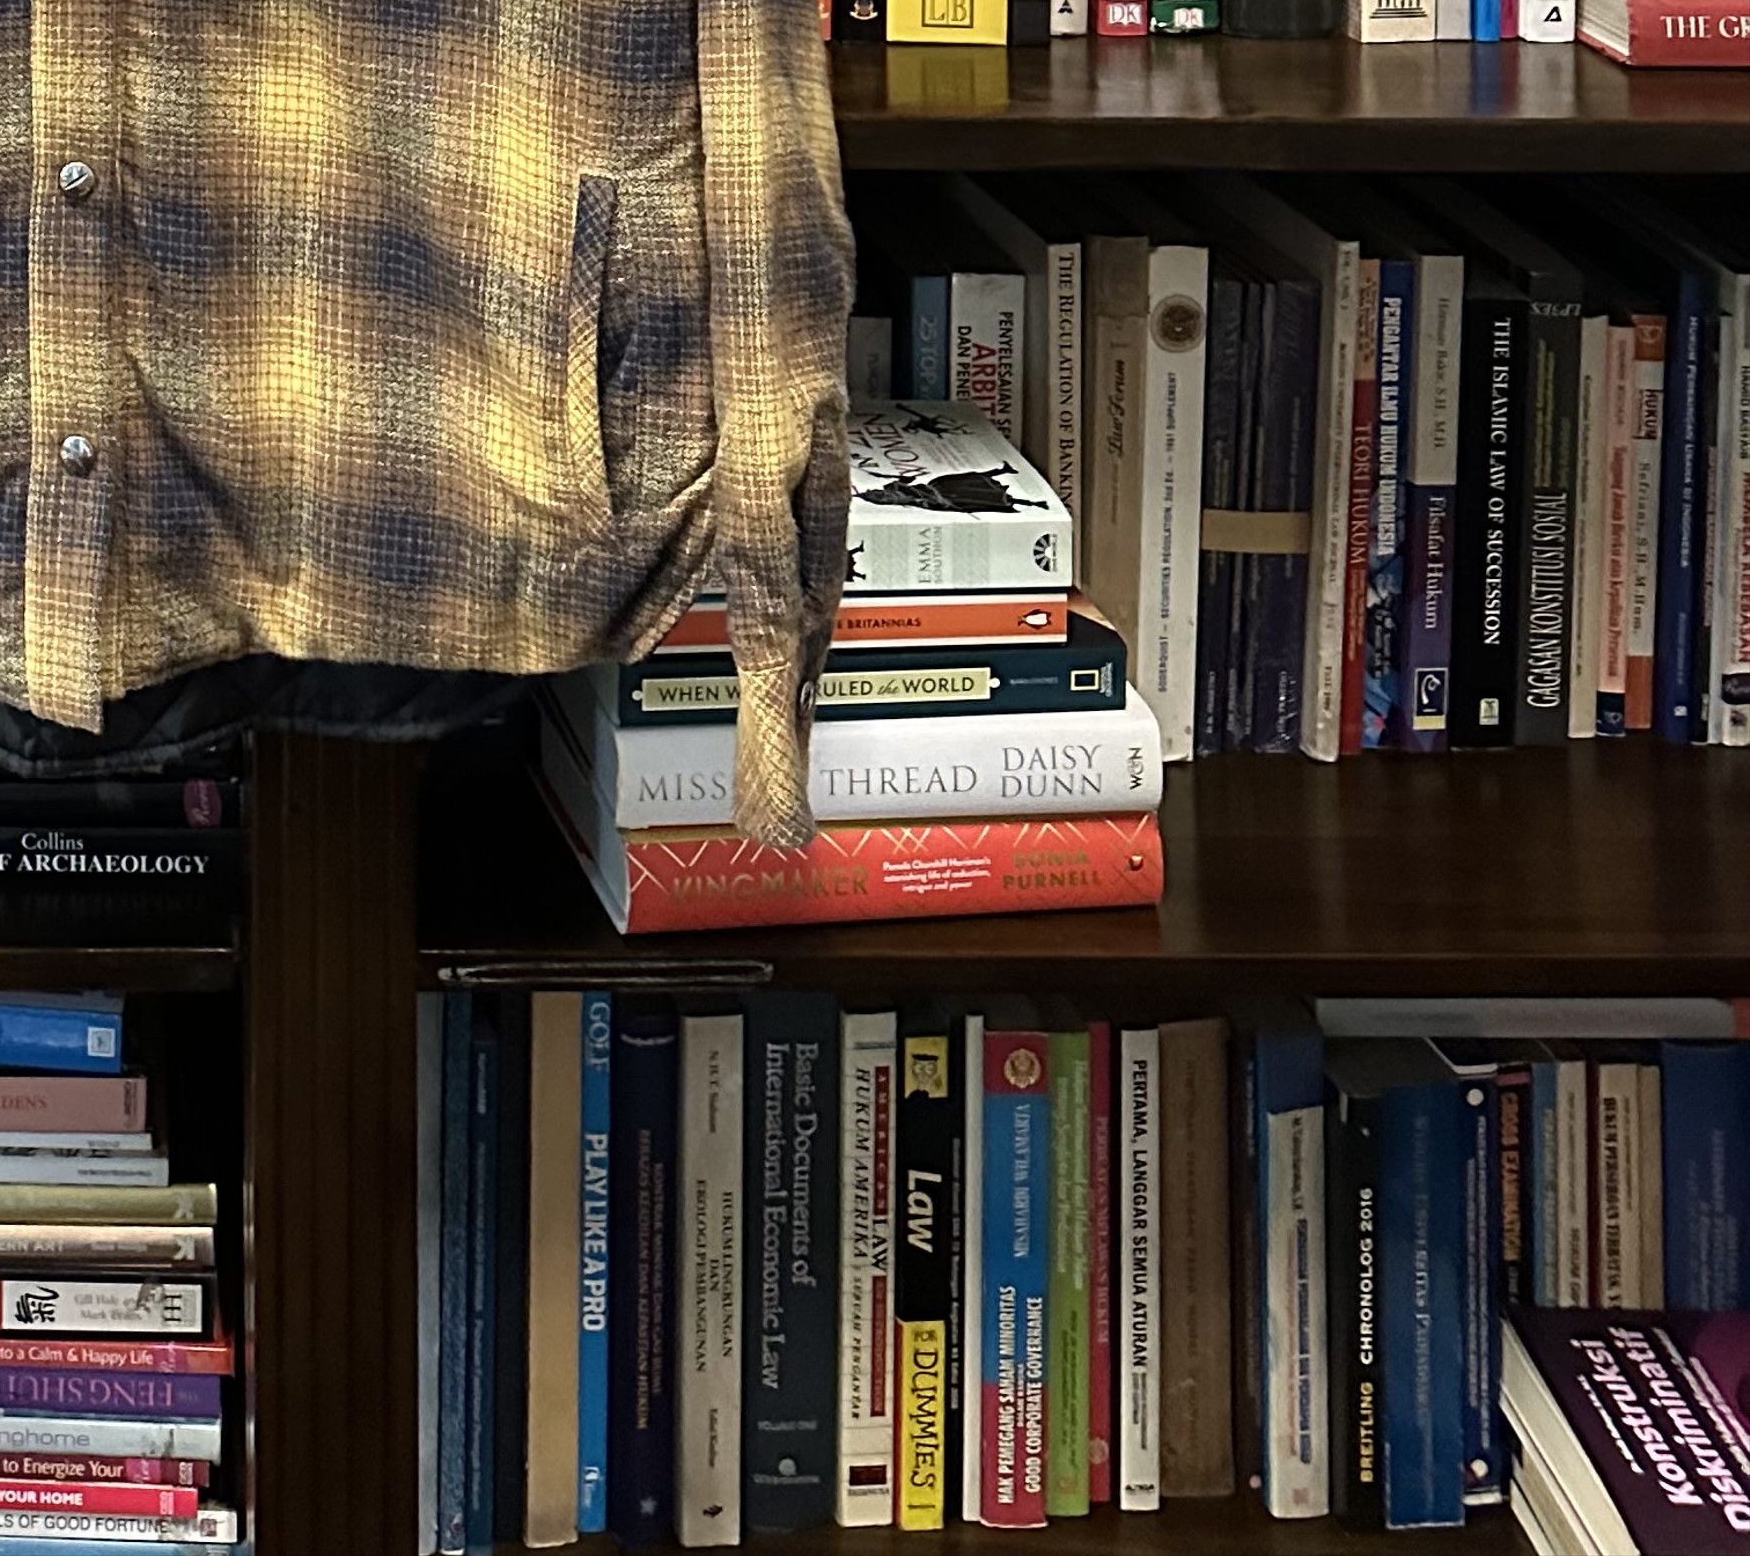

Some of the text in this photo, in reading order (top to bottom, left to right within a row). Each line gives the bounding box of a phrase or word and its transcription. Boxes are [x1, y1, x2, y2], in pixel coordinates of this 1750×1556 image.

[658, 684, 718, 702] WHEN
[902, 675, 974, 695] WORLD
[1004, 745, 1103, 772] DAISY
[639, 770, 726, 803] MISS
[822, 765, 978, 797] THREAD
[1001, 772, 1103, 798] DUNN
[22, 832, 83, 851] Collins
[18, 853, 208, 874] ARCHAEOLOGY
[907, 1169, 941, 1252] Law
[582, 1133, 607, 1332] PLAY LIKE A PRO
[1359, 1188, 1374, 1482] BREITLING CHRONOLOG 2016
[909, 1345, 937, 1491] DUMMIES
